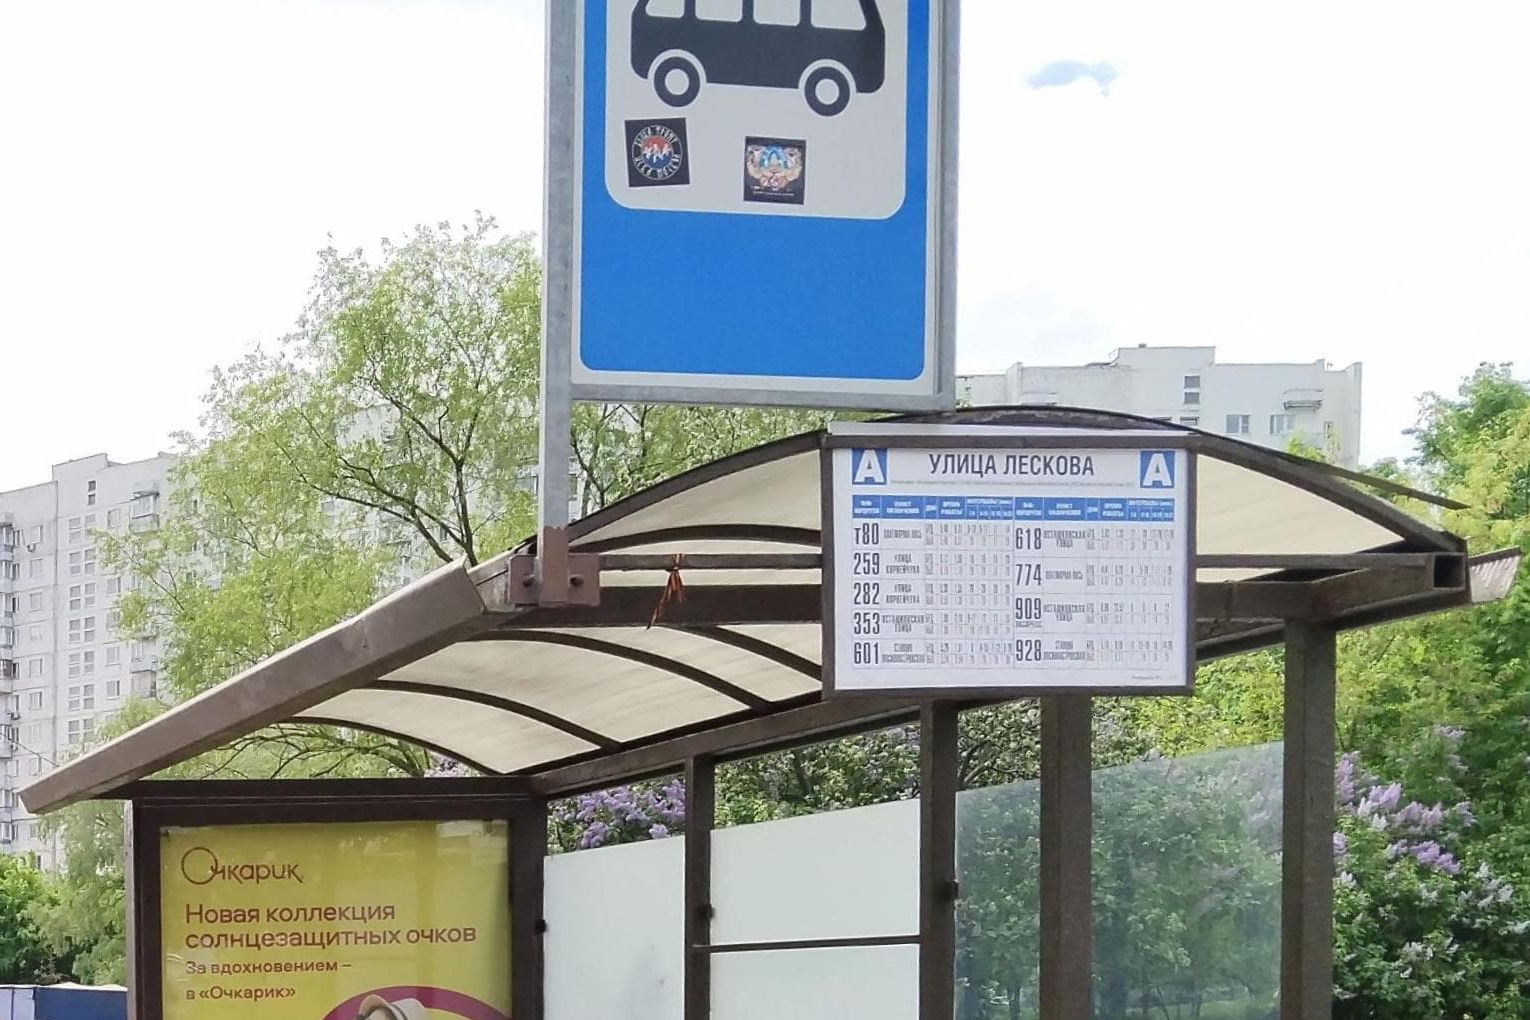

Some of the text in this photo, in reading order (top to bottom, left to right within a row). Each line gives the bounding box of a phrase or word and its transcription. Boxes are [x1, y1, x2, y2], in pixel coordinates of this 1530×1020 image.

[929, 453, 1095, 478] УЛИЦА ЛЕСКОВА
[1015, 527, 1042, 550] 618
[853, 552, 880, 575] 259
[1015, 563, 1042, 586] 774
[853, 582, 880, 605] 282
[1015, 597, 1042, 620] 909
[853, 612, 880, 635] 353
[853, 642, 879, 665] 601
[1015, 639, 1042, 662] 928
[181, 846, 303, 885] Очкарик
[185, 904, 395, 924] Новая коллекция
[185, 927, 476, 950] солнцезащитных очков
[186, 961, 206, 975] За
[211, 961, 338, 976] вдохновением
[186, 986, 295, 1002] в «Очкарик»
